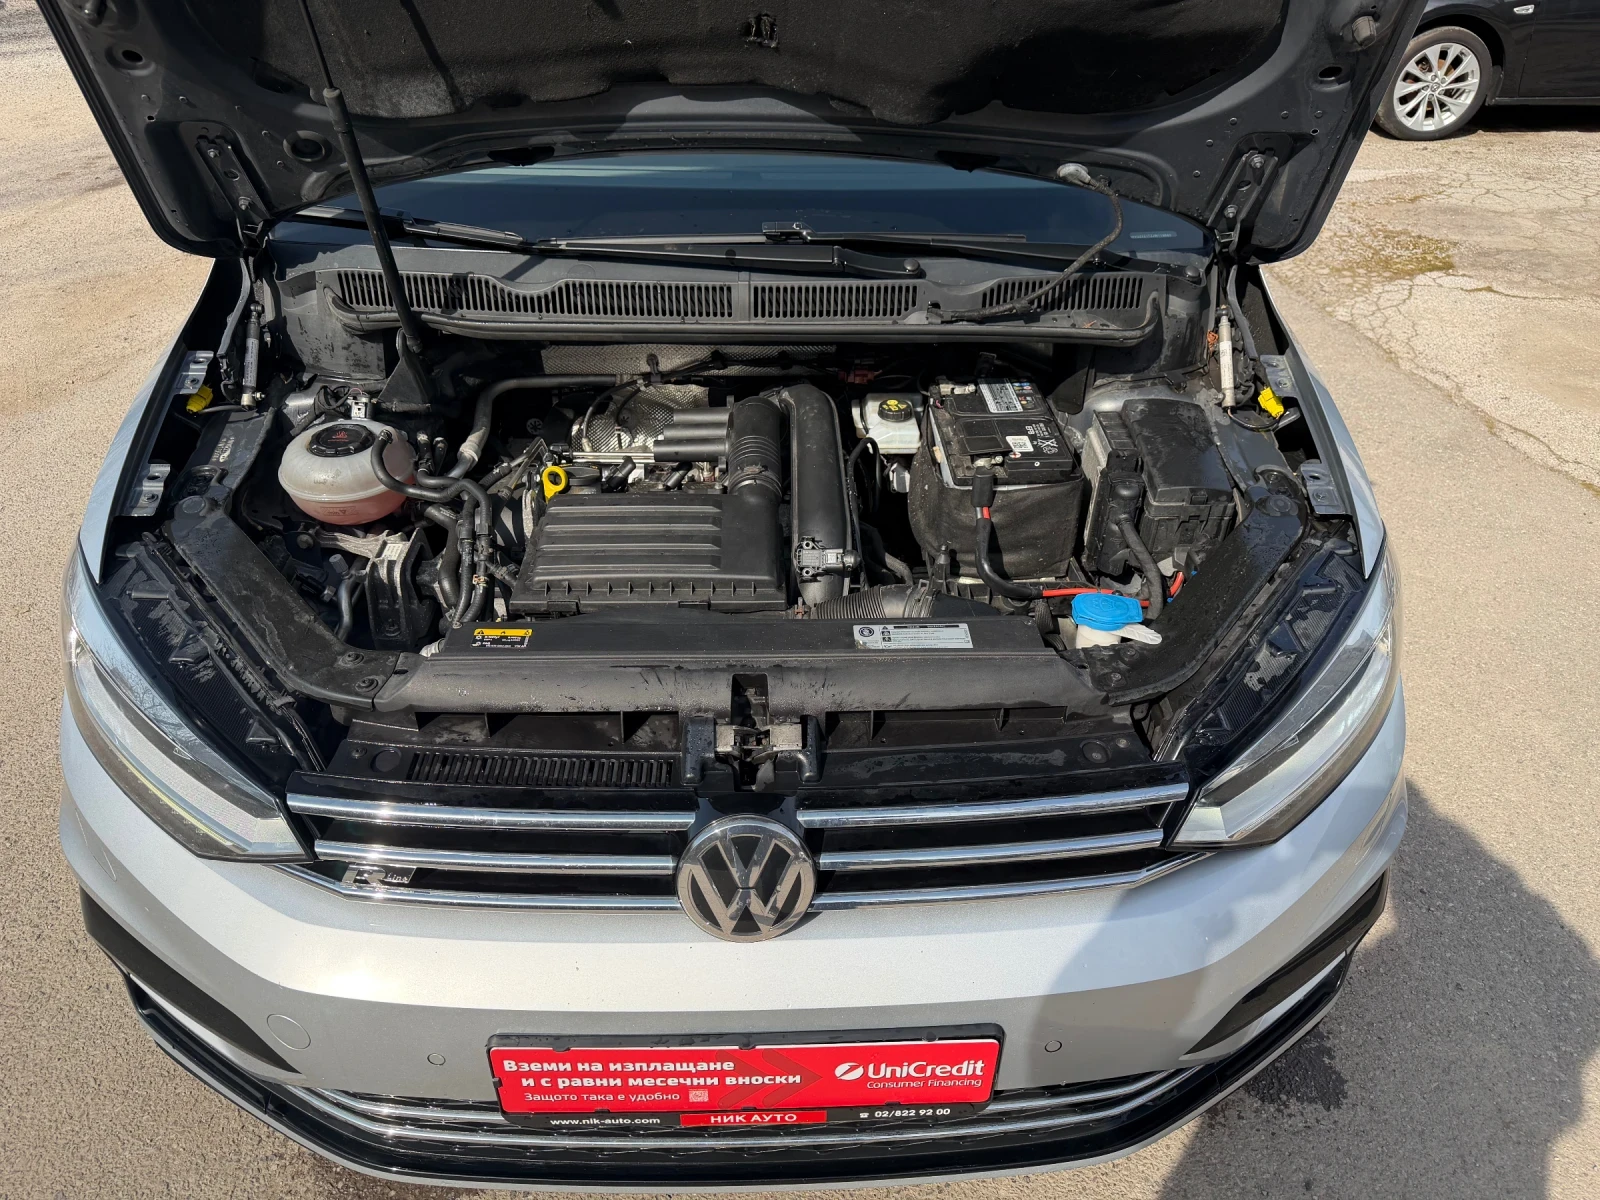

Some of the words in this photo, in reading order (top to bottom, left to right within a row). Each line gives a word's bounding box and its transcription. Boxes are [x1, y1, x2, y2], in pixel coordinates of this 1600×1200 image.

[341, 864, 386, 885] R
[503, 1060, 572, 1072] Вземи
[577, 1061, 604, 1072] на
[609, 1060, 735, 1073] изплащане
[867, 1059, 985, 1079] UniCredit
[521, 1077, 535, 1087] и
[540, 1077, 552, 1087] с
[557, 1077, 622, 1089] равни
[628, 1076, 720, 1087] месечни
[725, 1074, 801, 1085] вноски
[866, 1079, 926, 1089] Consumer
[928, 1078, 982, 1088] Financing
[524, 1092, 578, 1102] Защото
[581, 1093, 614, 1101] така
[617, 1093, 625, 1101] е
[628, 1092, 680, 1102] удобно
[710, 1114, 746, 1124] НИК
[746, 1113, 797, 1122] АУТО
[874, 1109, 916, 1118] 02/822
[918, 1109, 933, 1117] 92
[935, 1108, 951, 1116] 00
[550, 1117, 661, 1125] www.nik-auto.com
